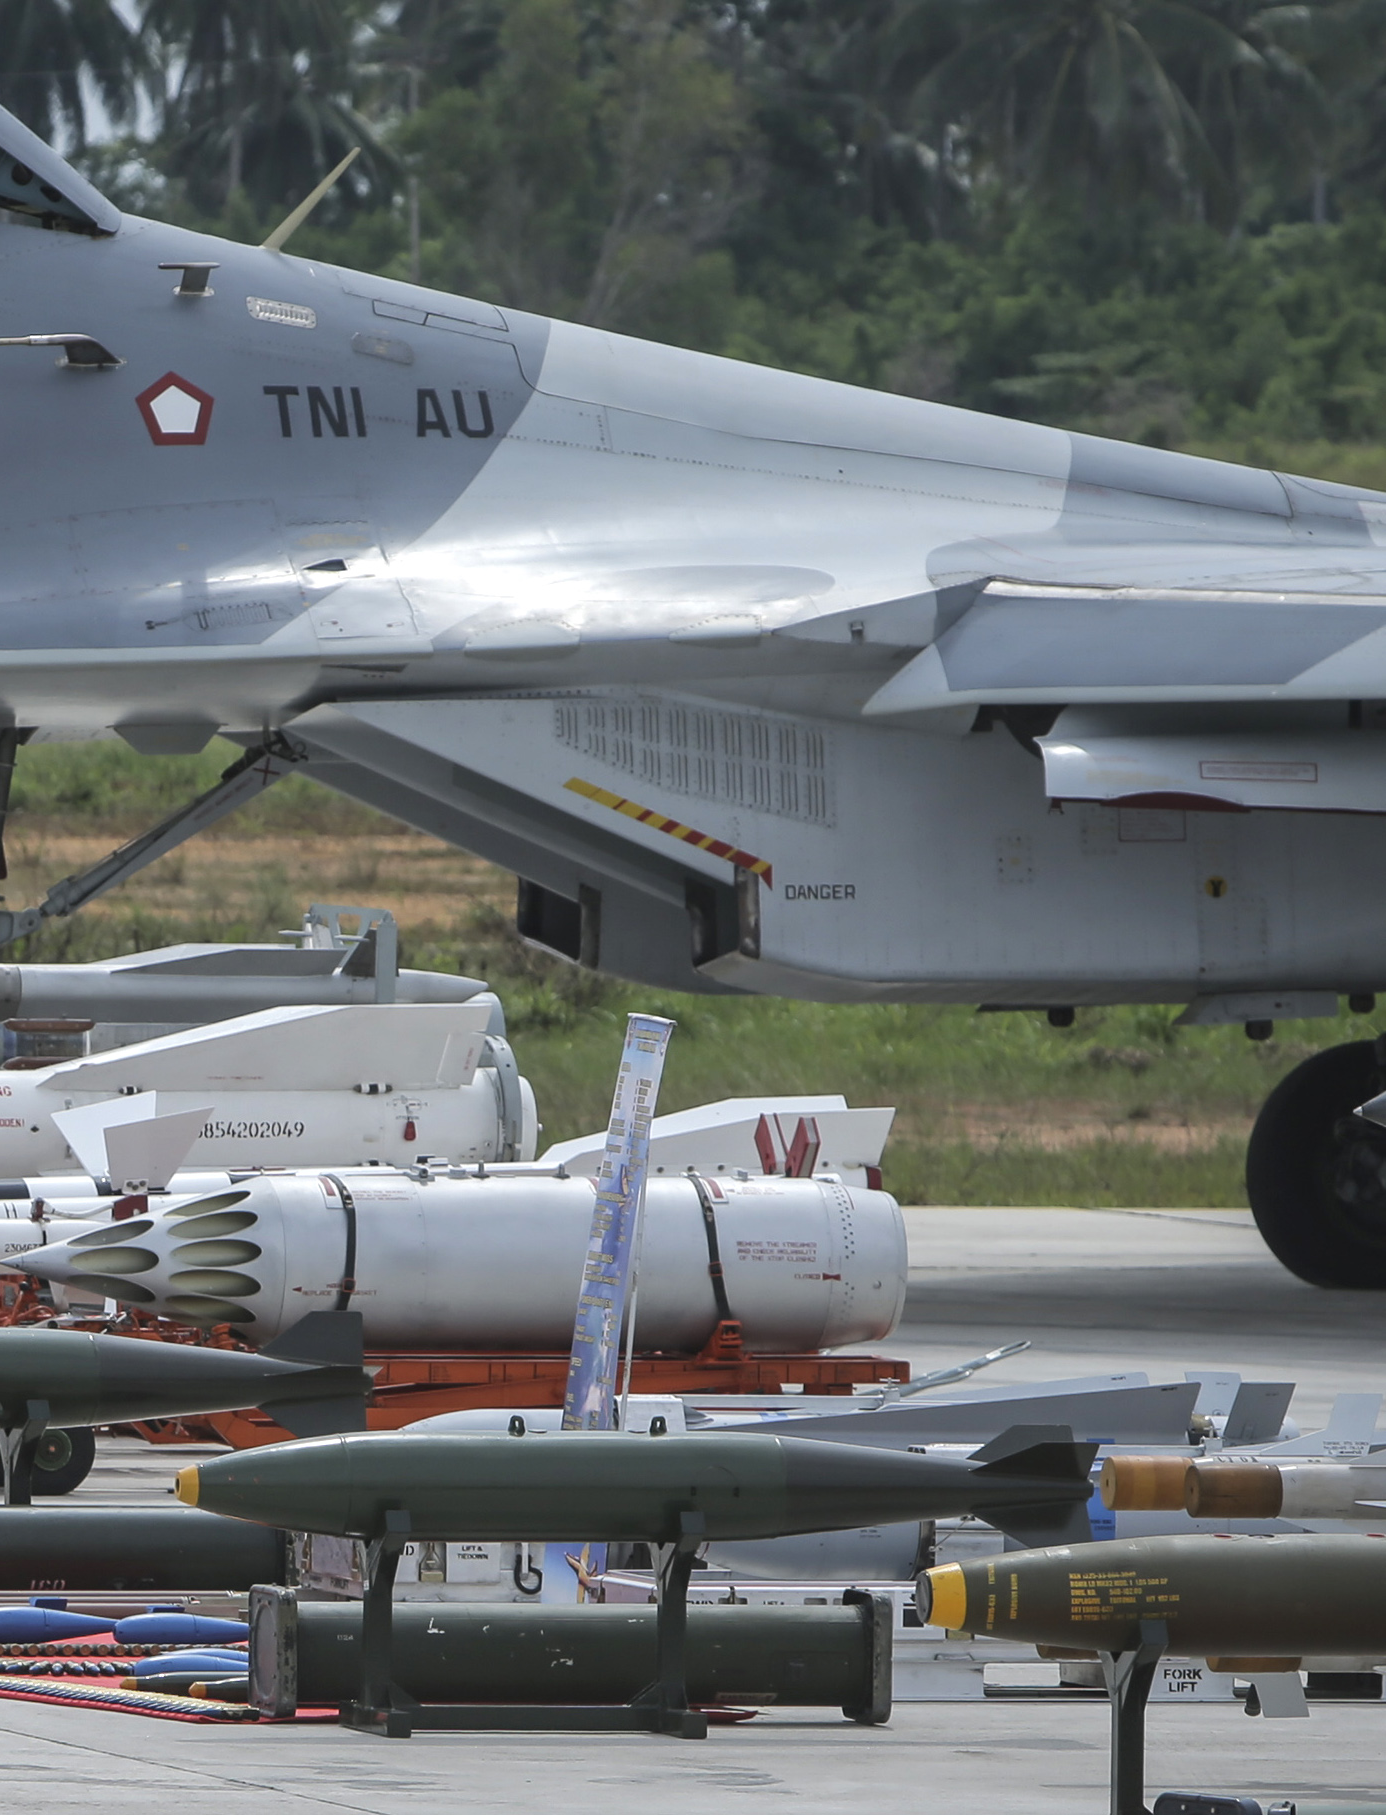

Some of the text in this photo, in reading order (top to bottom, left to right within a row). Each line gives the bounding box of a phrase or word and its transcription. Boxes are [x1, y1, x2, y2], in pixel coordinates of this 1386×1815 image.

[263, 386, 495, 438] TNI AU
[785, 884, 856, 900] DANGER
[198, 1121, 304, 1139] 854202049
[1164, 1668, 1202, 1680] FORK
[1169, 1682, 1198, 1692] LIFT
